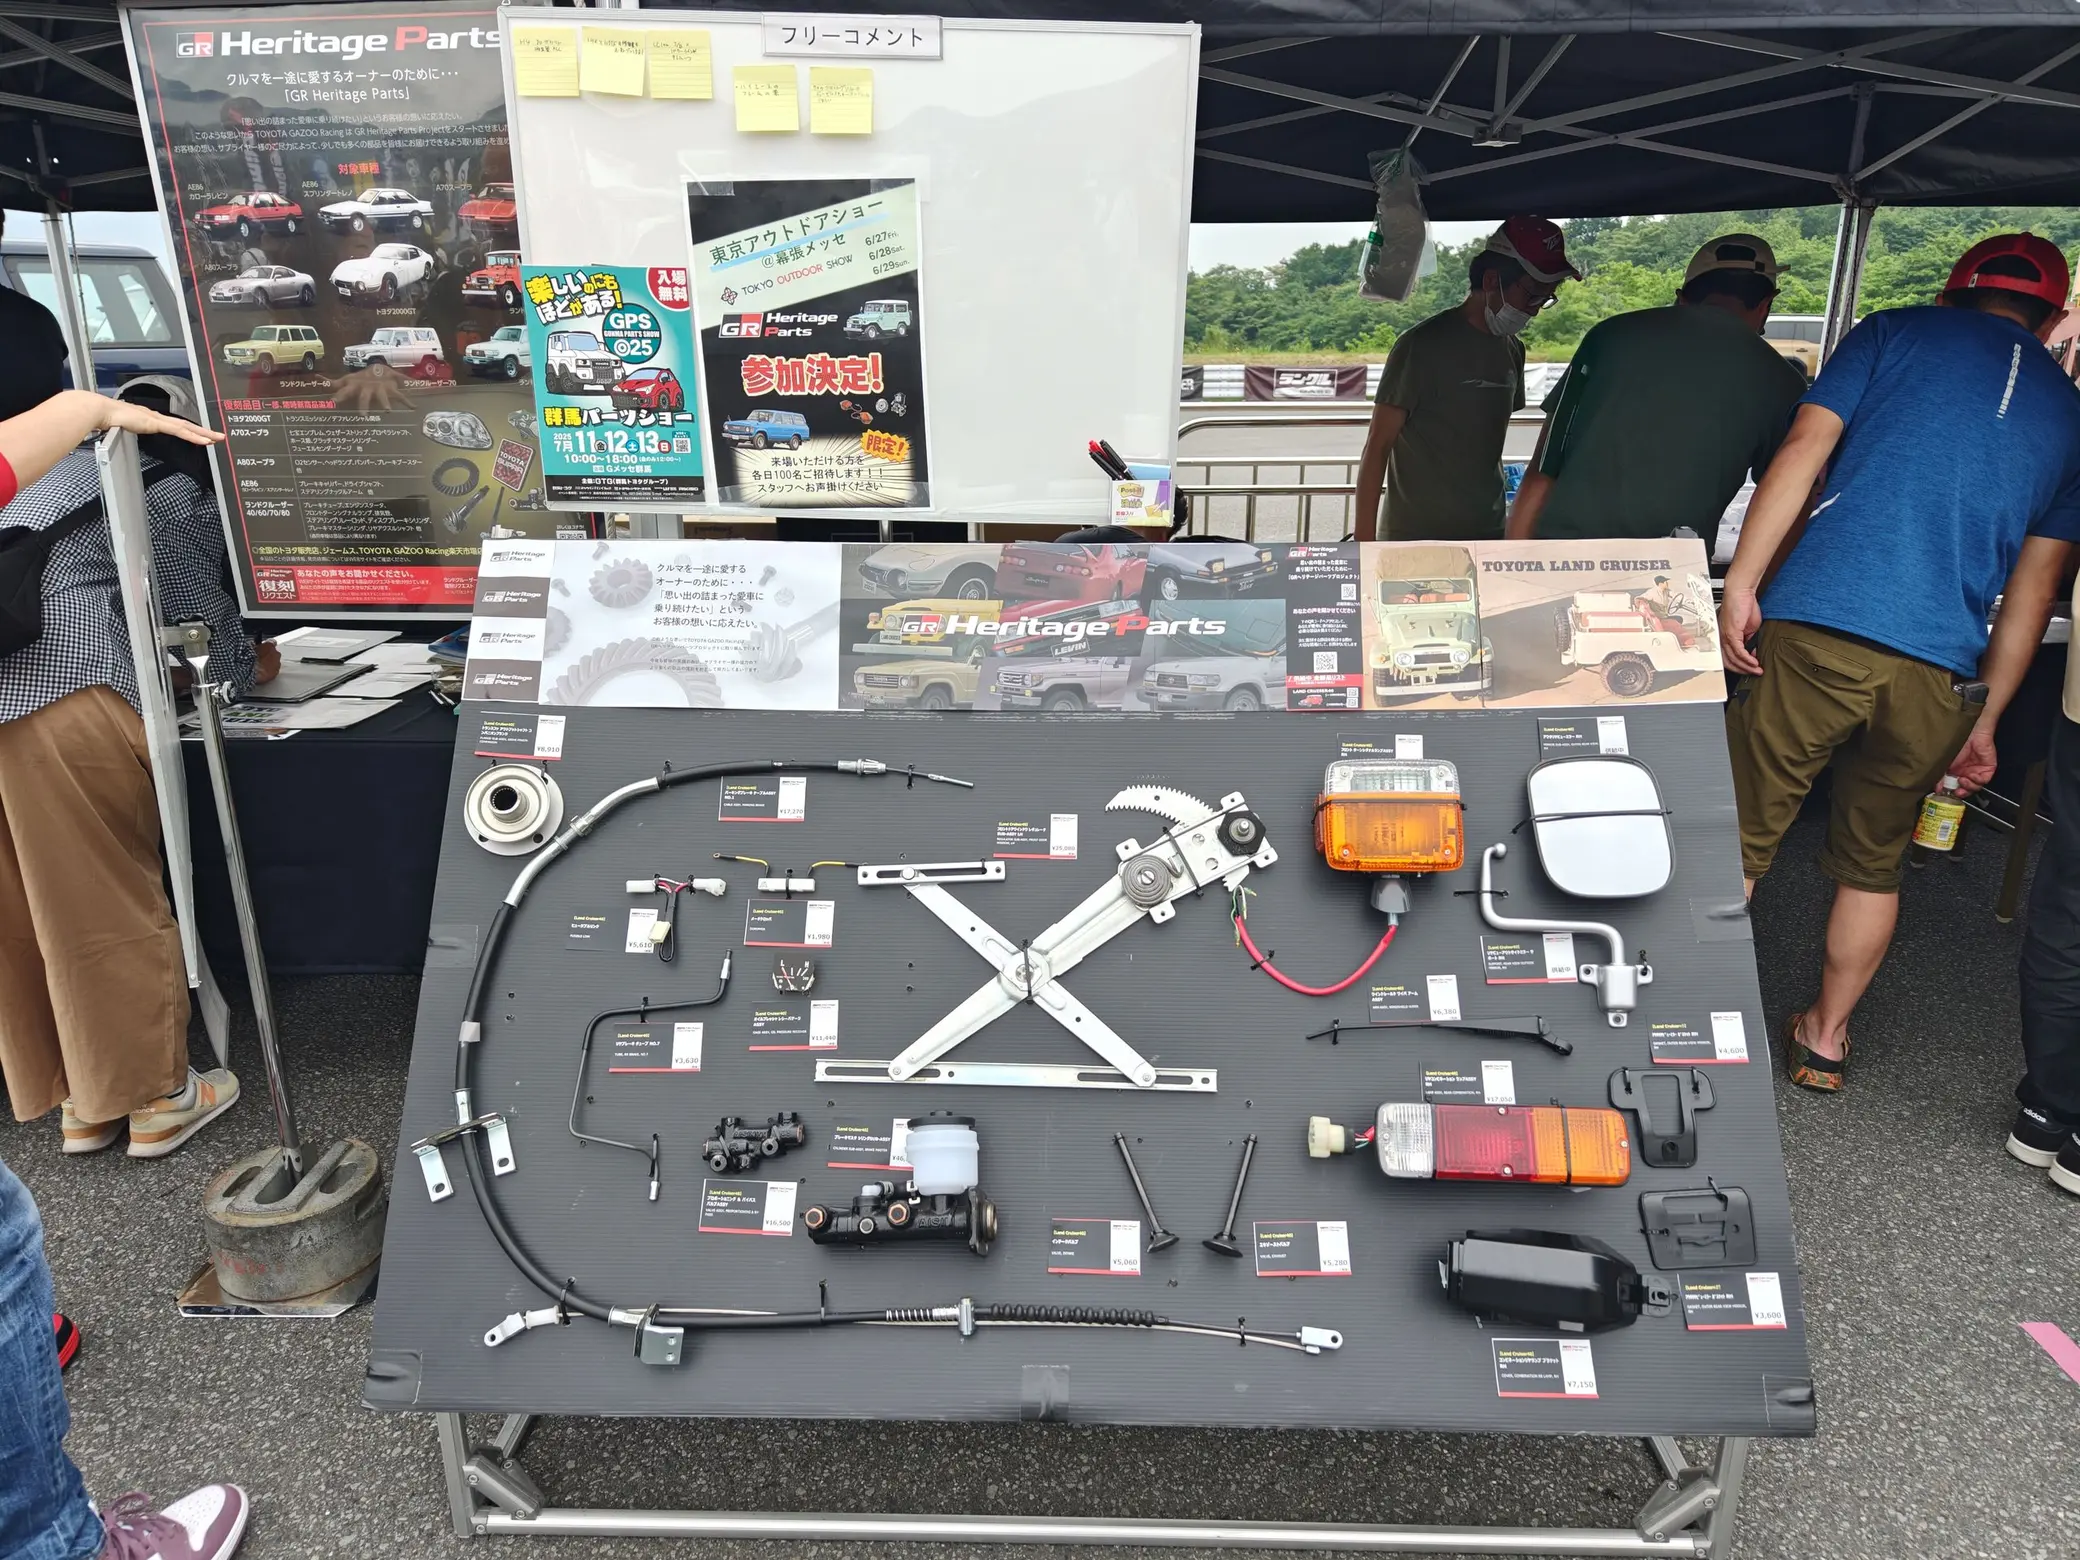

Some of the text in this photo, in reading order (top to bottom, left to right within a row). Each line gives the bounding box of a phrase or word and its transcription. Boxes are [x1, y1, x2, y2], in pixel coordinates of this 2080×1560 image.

[177, 41, 213, 56] GR
[221, 30, 388, 60] Heritage
[395, 26, 501, 50] Parts
[783, 25, 924, 48] フリーコメント
[313, 88, 368, 104] Heritage
[255, 129, 287, 139] TOYOTA
[289, 128, 318, 138] GAZOO
[320, 127, 345, 138] Racing
[367, 126, 397, 137] Heritage
[399, 126, 417, 136] Parts
[338, 161, 381, 176] 対象車種
[302, 180, 318, 189] AE86
[709, 200, 884, 266] 東京アウトドアショー
[657, 269, 687, 286] 入場
[741, 253, 853, 297] TOKYO OUTDOOR SHOW
[658, 286, 688, 302] 無料
[609, 313, 652, 330] GPS
[721, 312, 838, 336] GR Heritage
[765, 326, 812, 337] Parts
[1278, 373, 1332, 386] ランクル
[543, 406, 695, 428] 群馬パーツショー
[554, 440, 573, 452] 7月
[574, 430, 597, 453] 11
[604, 430, 629, 453] 12
[636, 430, 660, 453] 13
[500, 451, 524, 466] TOYOTA
[771, 454, 866, 466] 来場いただける方を
[244, 501, 294, 509] ランドクルーザー
[393, 546, 424, 555] GAZOO
[656, 564, 746, 574] クルマを一途に愛する
[1482, 558, 1672, 573] TOYOTA LAND CRUISER
[259, 580, 295, 592] 復刻
[262, 592, 297, 600] リクエスト
[902, 614, 1226, 642] GR Heritage Parts
[1054, 641, 1087, 656] LEVIN
